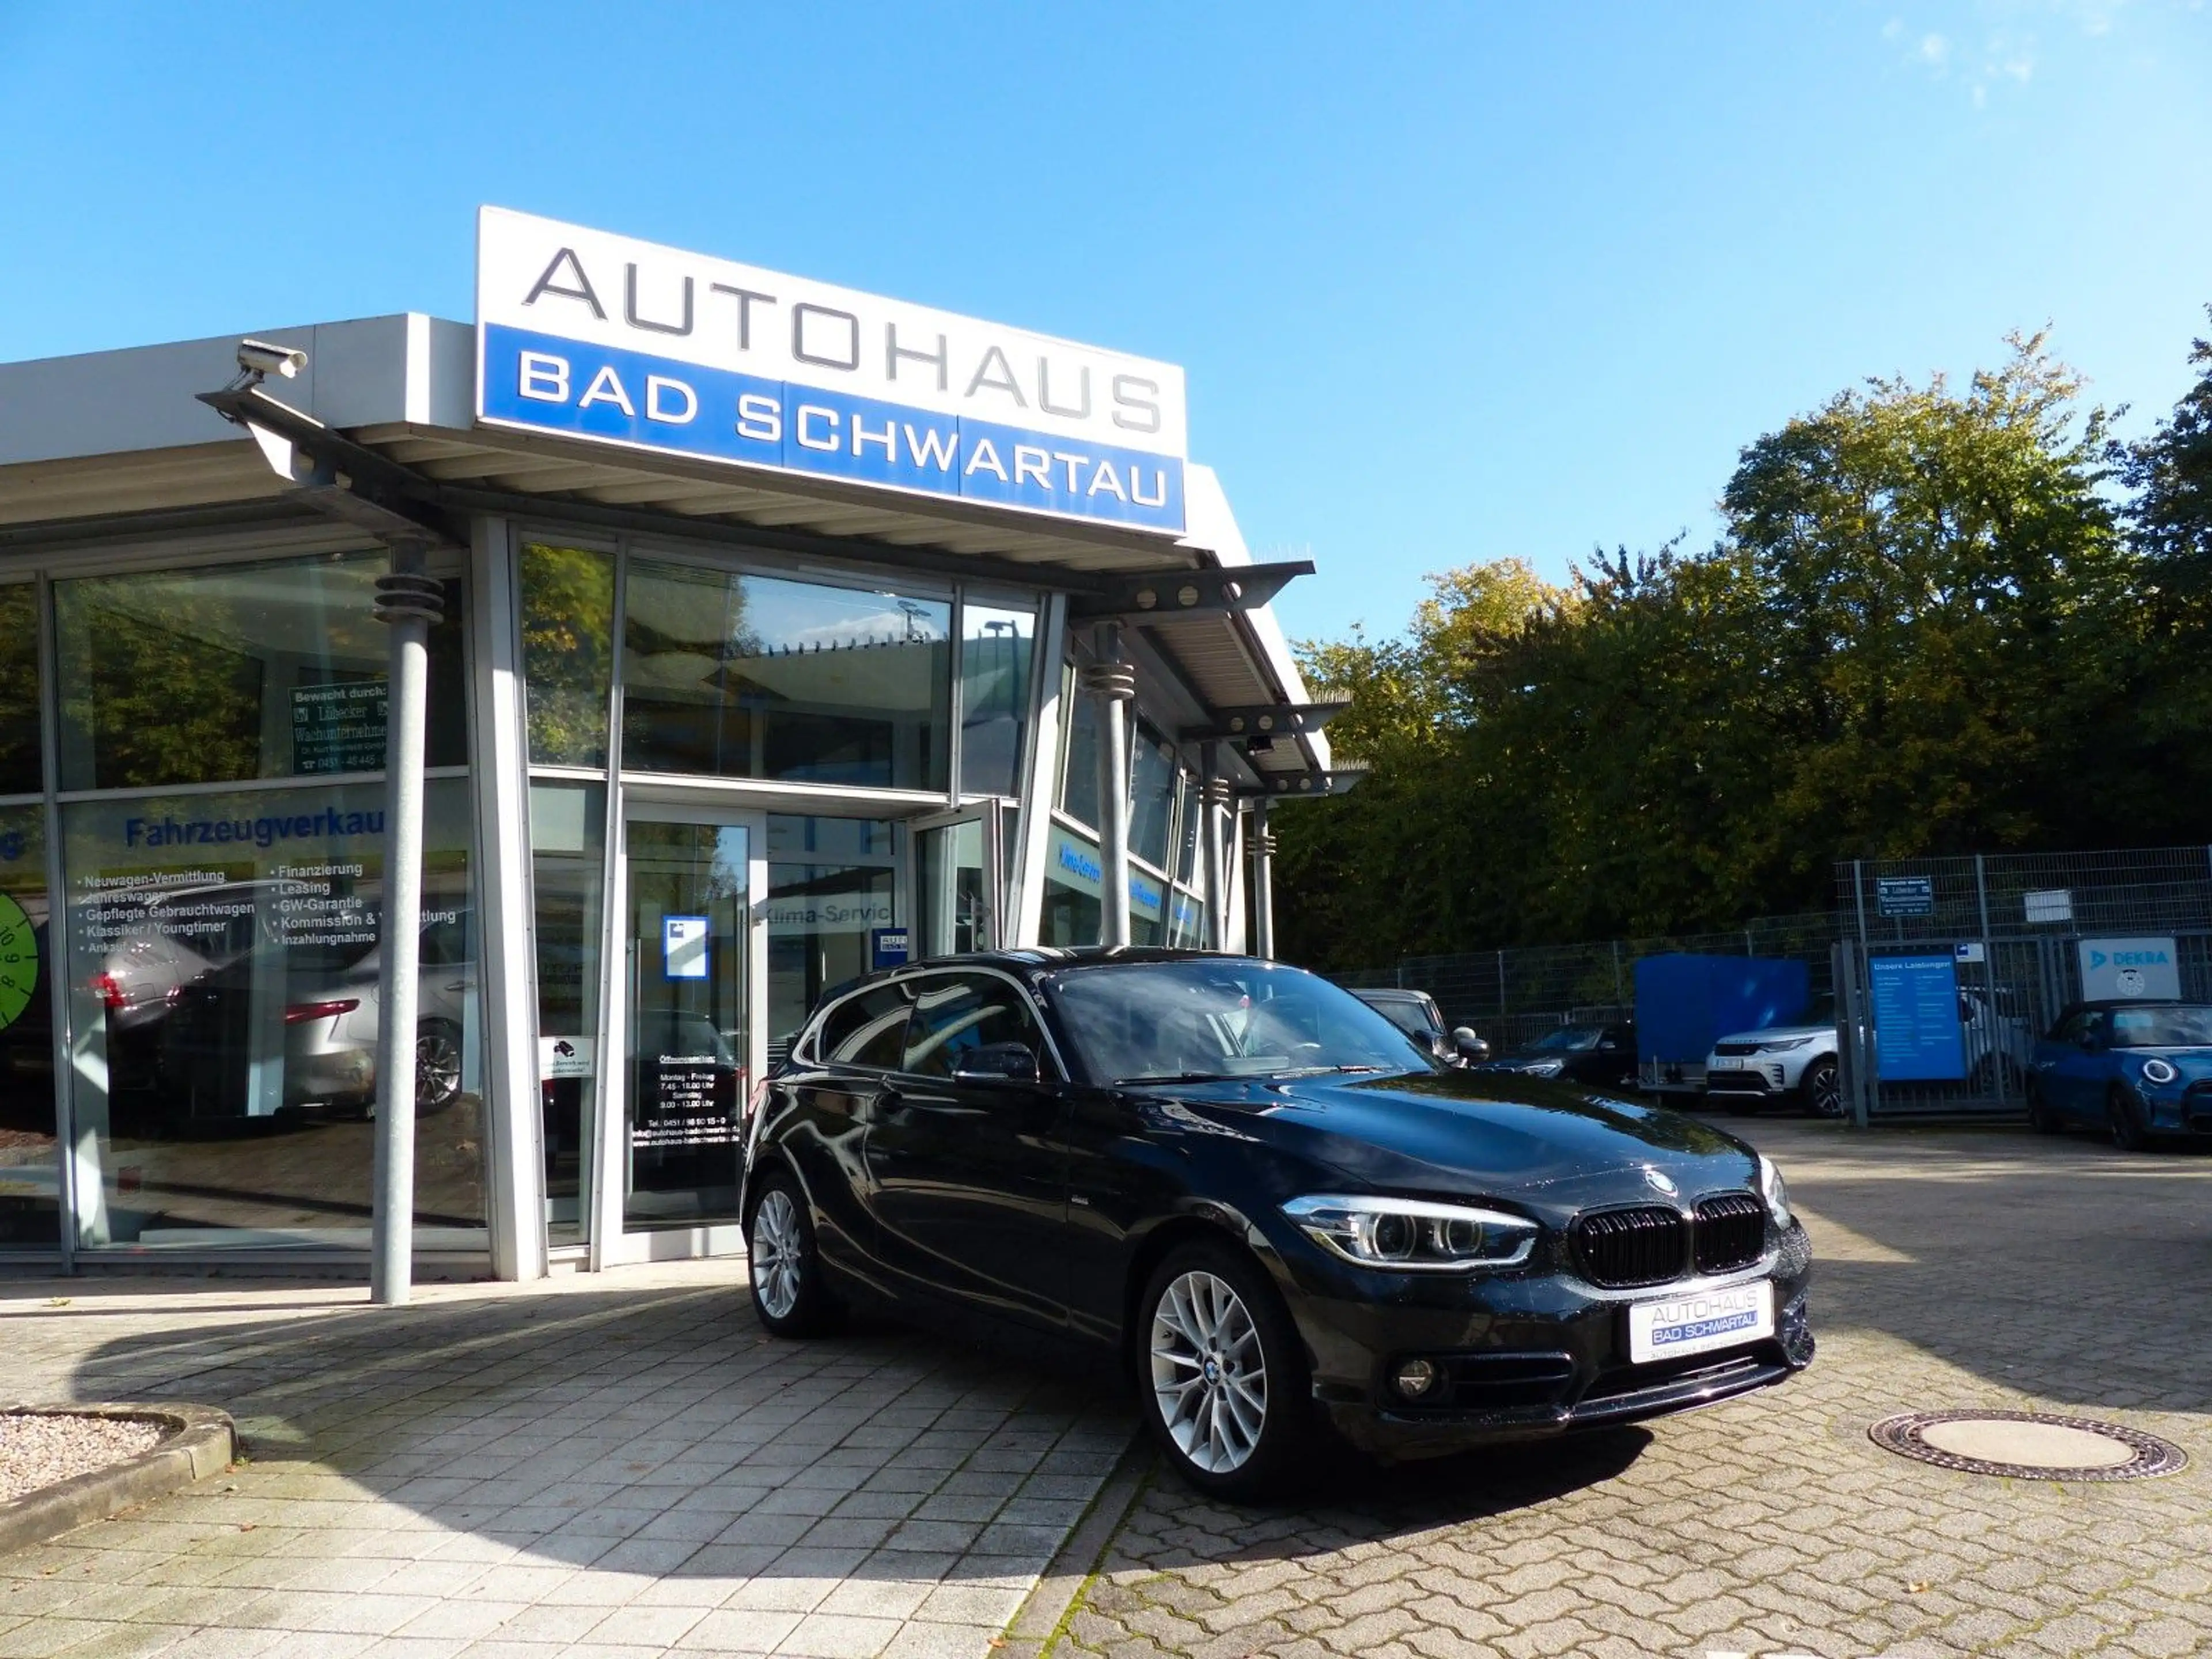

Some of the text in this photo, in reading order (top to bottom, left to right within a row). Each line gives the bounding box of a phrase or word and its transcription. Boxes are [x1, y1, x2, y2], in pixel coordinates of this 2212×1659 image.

[521, 247, 1162, 433] AUTOHAUS
[519, 350, 1166, 507] BAD SCHWARTAU
[295, 690, 346, 703] Bewacht
[295, 722, 387, 742] Wachunternehme
[126, 807, 385, 848] Fahrzeugverkau
[278, 863, 363, 877] Finanzierung
[85, 870, 225, 888] Neuwagen-Vermittlung
[279, 881, 330, 896] Leasing
[86, 903, 255, 923] Gepflegte Gebrauchtwagen
[281, 897, 362, 912] GW-Garantie
[281, 914, 362, 929] Kommission
[366, 912, 376, 925] &
[766, 904, 889, 924] Klima-Servic
[87, 925, 143, 938] Klassiker
[154, 921, 226, 936] Youngtimer
[89, 941, 127, 953] Ankauf
[282, 932, 376, 946] Inzahlungnahme
[2113, 951, 2168, 966] DEKRA
[660, 1074, 685, 1082] Montag
[691, 1072, 715, 1082] Freitag
[672, 1092, 702, 1100] Samstag
[1652, 1290, 1757, 1324] AUTOHAUS
[1653, 1310, 1757, 1344] BAD SCHWARTAU
